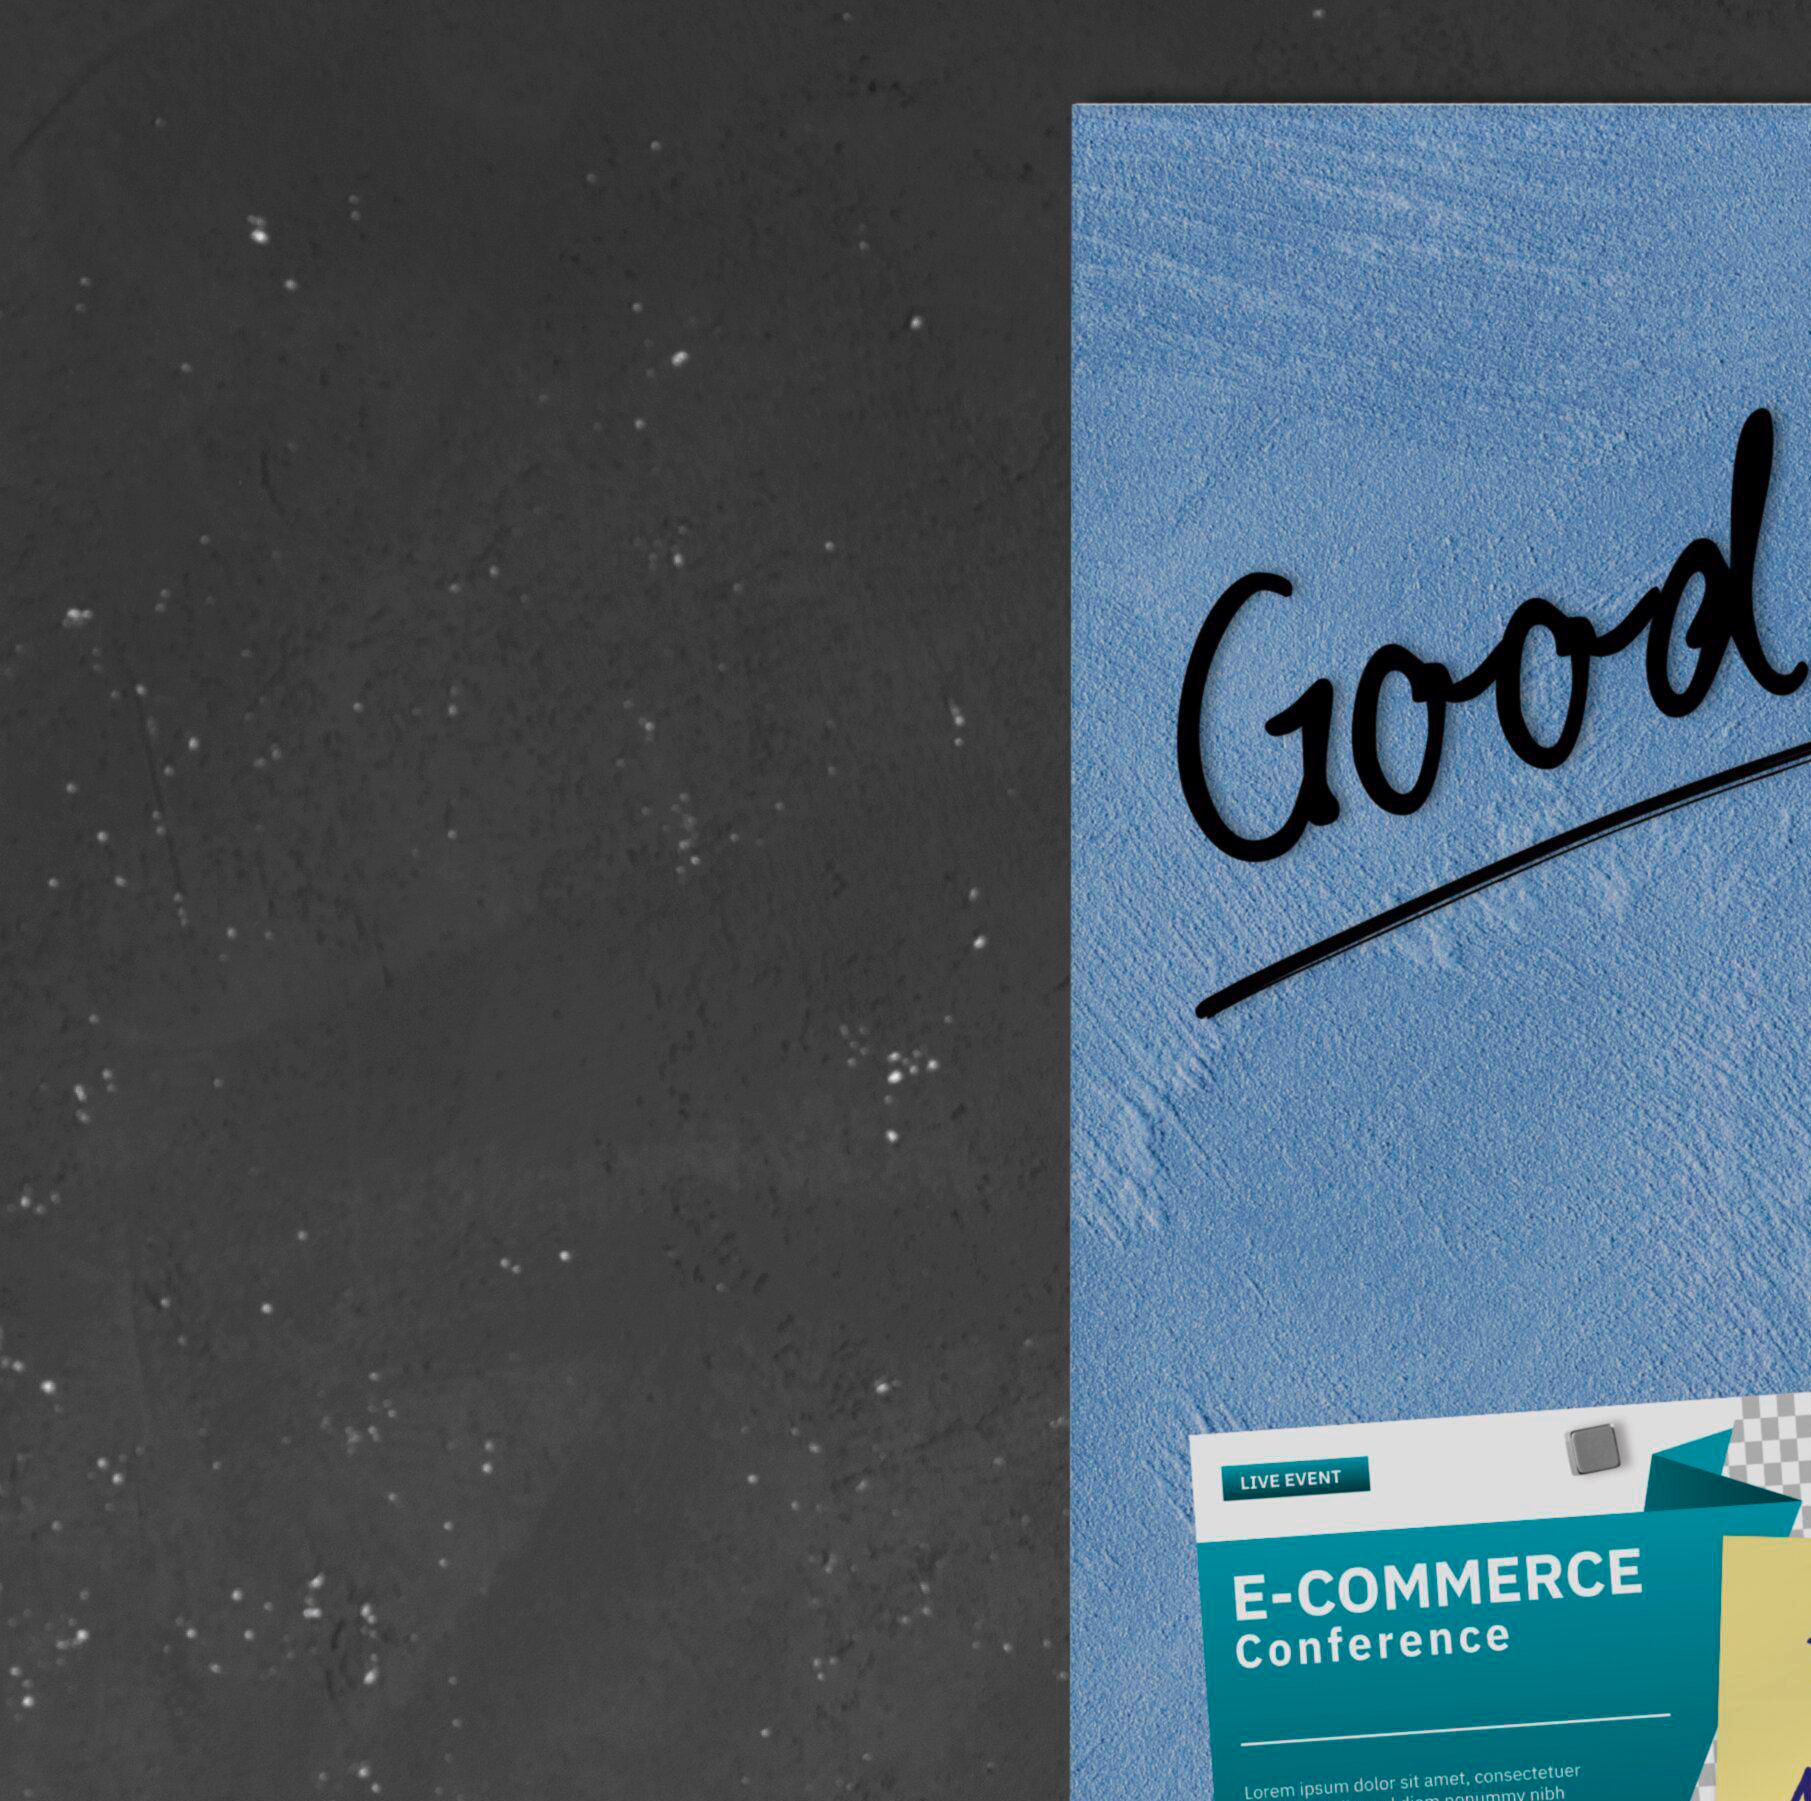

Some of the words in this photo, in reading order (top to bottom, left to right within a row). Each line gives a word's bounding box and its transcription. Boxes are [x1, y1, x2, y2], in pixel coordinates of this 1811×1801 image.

[1239, 1472, 1281, 1491] LIVE
[1283, 1468, 1343, 1488] EVENT
[1233, 1547, 1643, 1621] E-COMMERCE
[1235, 1624, 1510, 1669] Conference
[1243, 1784, 1296, 1801] Lorem
[1299, 1780, 1350, 1800] ipsum
[1352, 1775, 1397, 1794] dolor
[1399, 1774, 1420, 1791] sit
[1423, 1770, 1471, 1789] amet,
[1473, 1765, 1582, 1785] consectetuer
